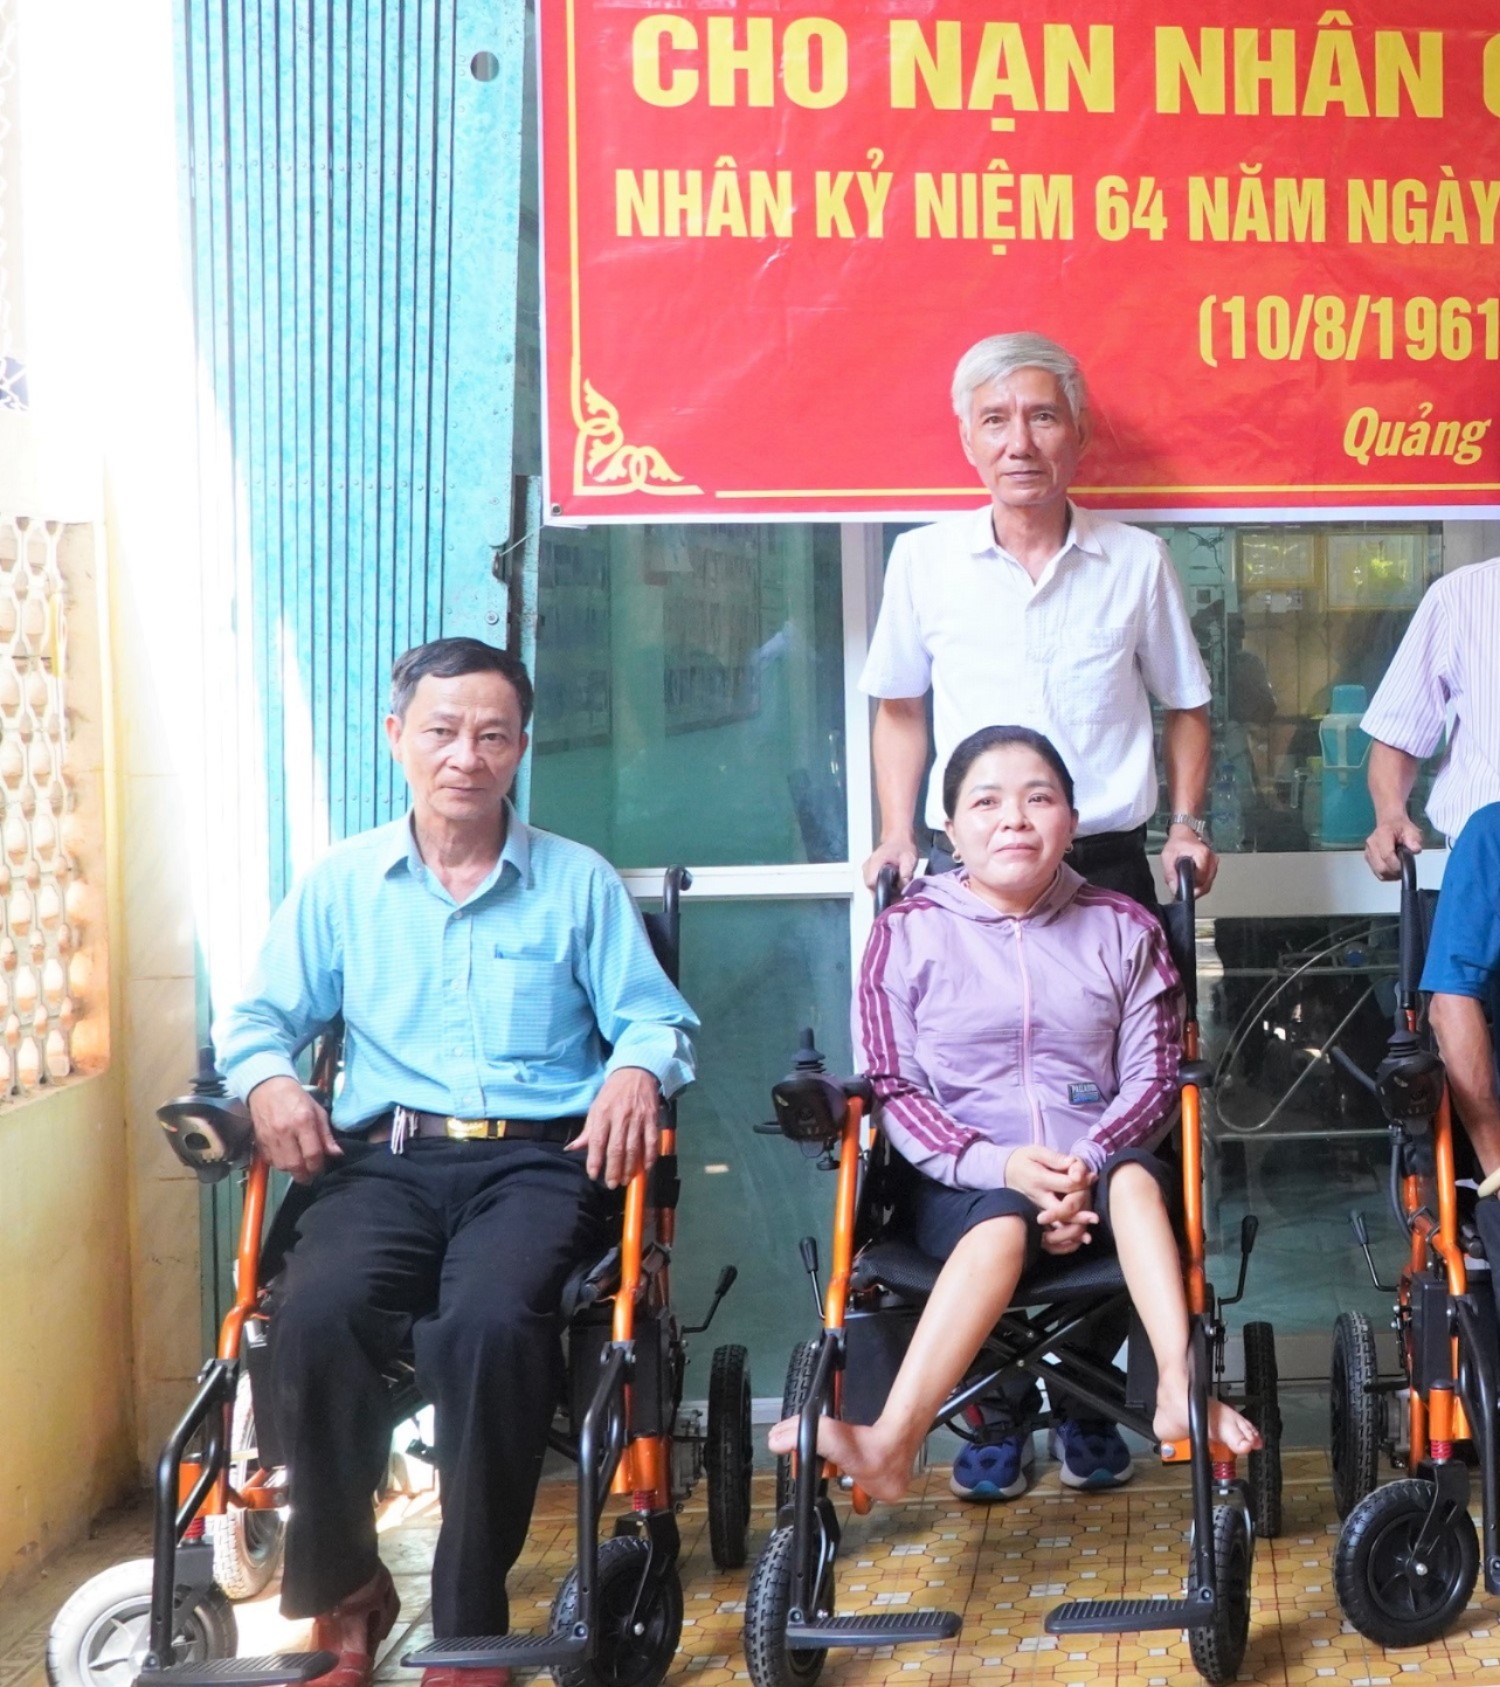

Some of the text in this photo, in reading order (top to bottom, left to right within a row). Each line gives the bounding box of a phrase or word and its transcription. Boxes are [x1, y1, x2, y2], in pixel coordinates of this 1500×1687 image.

[633, 15, 848, 108] CHO
[890, 20, 1114, 131] NẠN
[1155, 10, 1443, 118] NHÂN
[617, 156, 792, 236] NHÂN
[816, 148, 892, 238] KỶ
[916, 160, 1073, 255] NIỆM
[1096, 175, 1168, 241] 64
[1189, 163, 1325, 243] NĂM
[1199, 295, 1500, 365] (10/8/1961
[1343, 402, 1490, 465] Quảng
